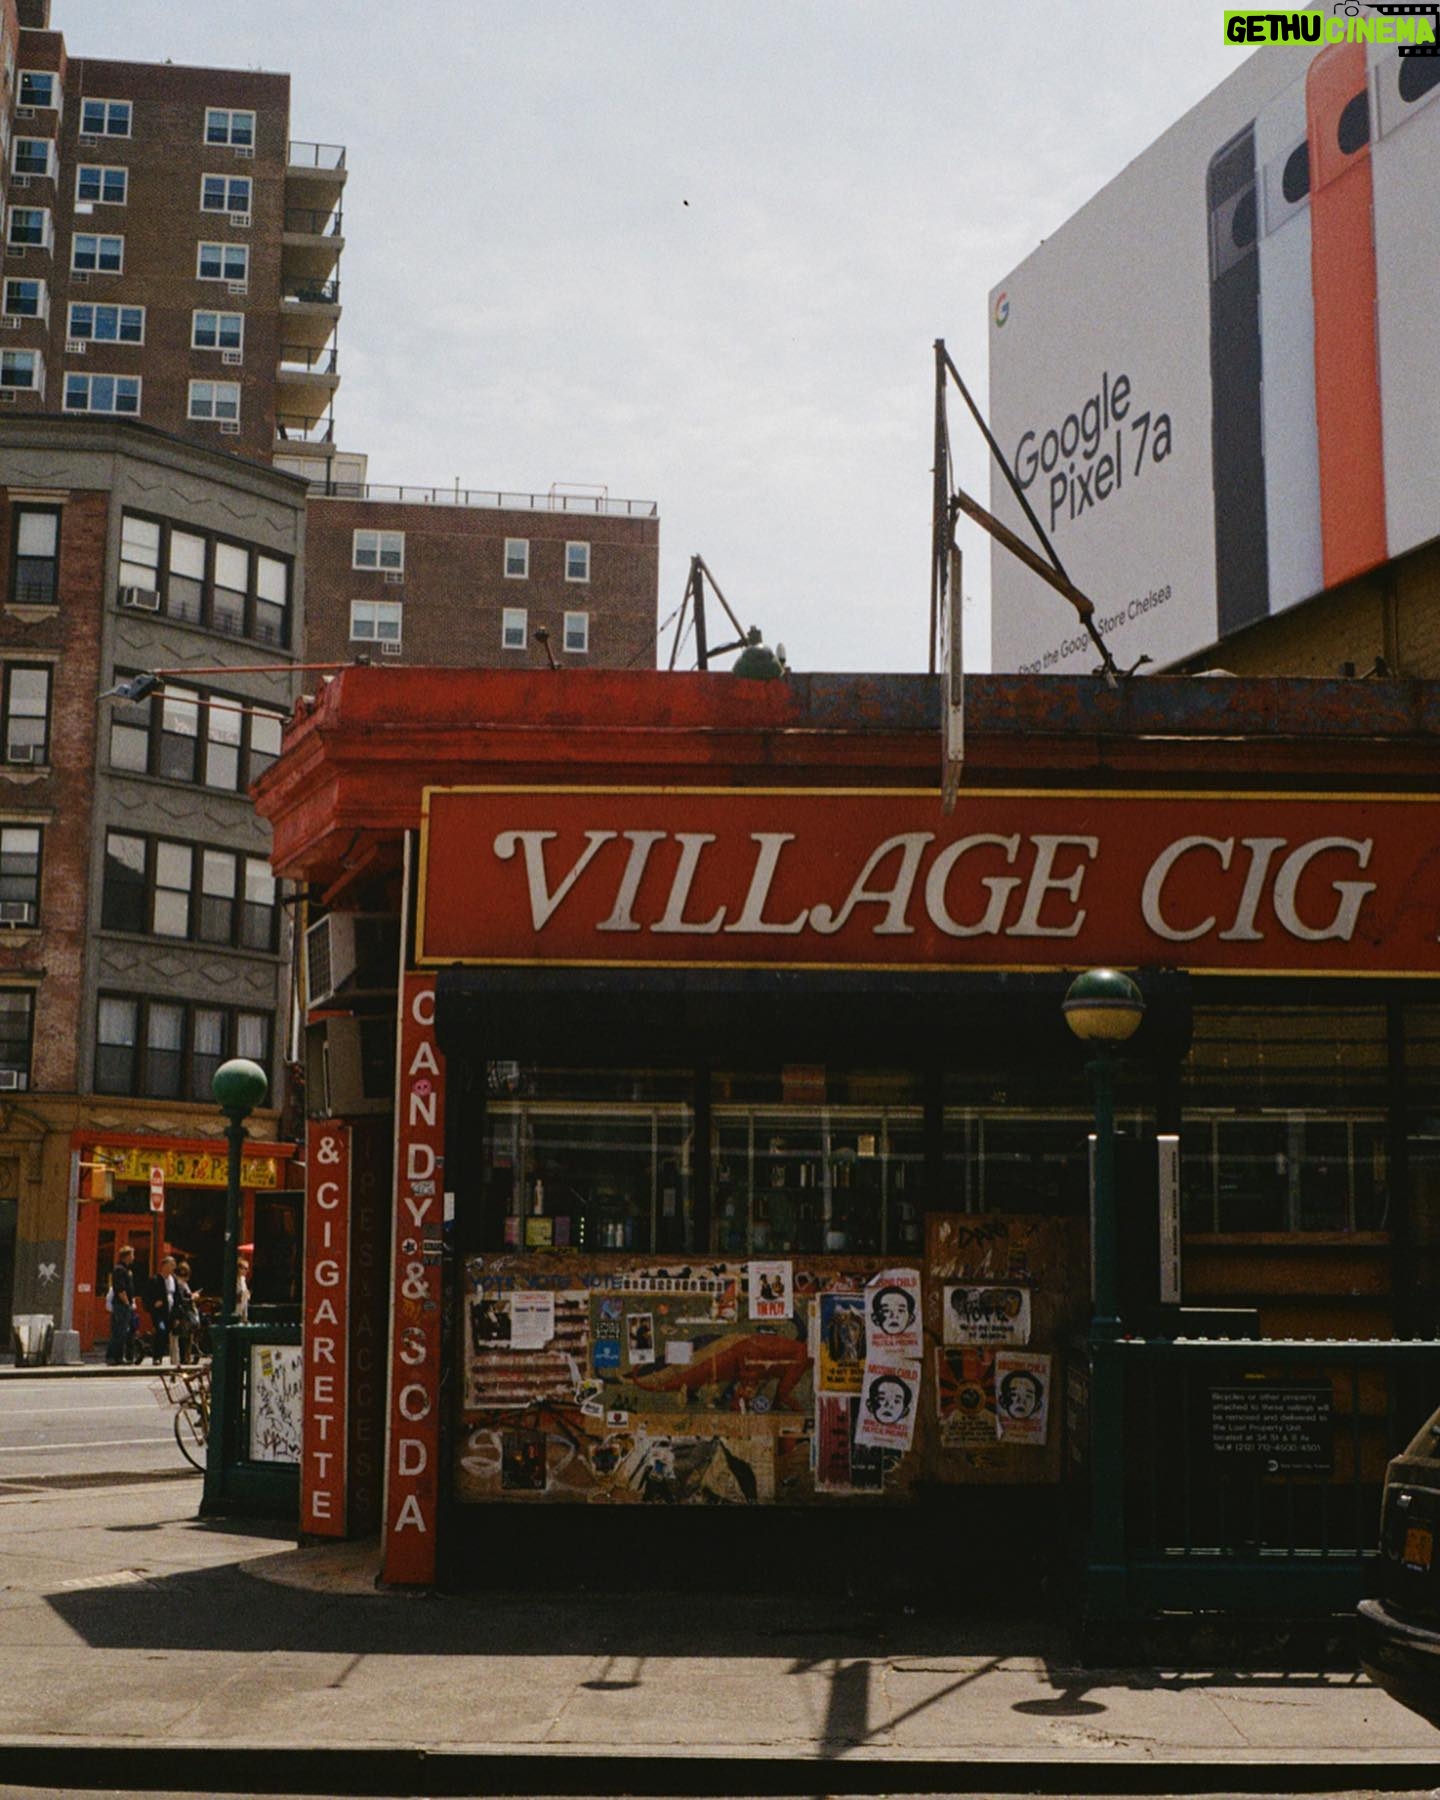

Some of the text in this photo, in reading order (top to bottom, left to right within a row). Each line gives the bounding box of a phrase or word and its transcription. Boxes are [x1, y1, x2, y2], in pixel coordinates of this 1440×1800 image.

[1014, 371, 1131, 493] Google
[1050, 411, 1172, 533] Pixel 7a
[1042, 649, 1059, 670] the
[1097, 611, 1127, 639] Store
[1127, 584, 1172, 622] Chelsea
[493, 829, 1376, 943] VILLAGE CIG
[404, 990, 440, 1227] CANDY
[402, 1262, 431, 1300] &
[312, 1137, 341, 1518] & CIGARETTE
[394, 1326, 432, 1532] SODA
[1211, 1392, 1317, 1403] Bicycles or other property
[1212, 1403, 1248, 1411] attached
[1250, 1403, 1260, 1411] to
[1261, 1403, 1285, 1411] these
[1317, 1403, 1330, 1411] will
[1212, 1413, 1328, 1421] be removed and delivered to
[1212, 1423, 1226, 1432] the
[1228, 1423, 1246, 1432] Lost
[1248, 1423, 1283, 1433] Property
[1212, 1433, 1243, 1441] located
[1245, 1433, 1254, 1441] at
